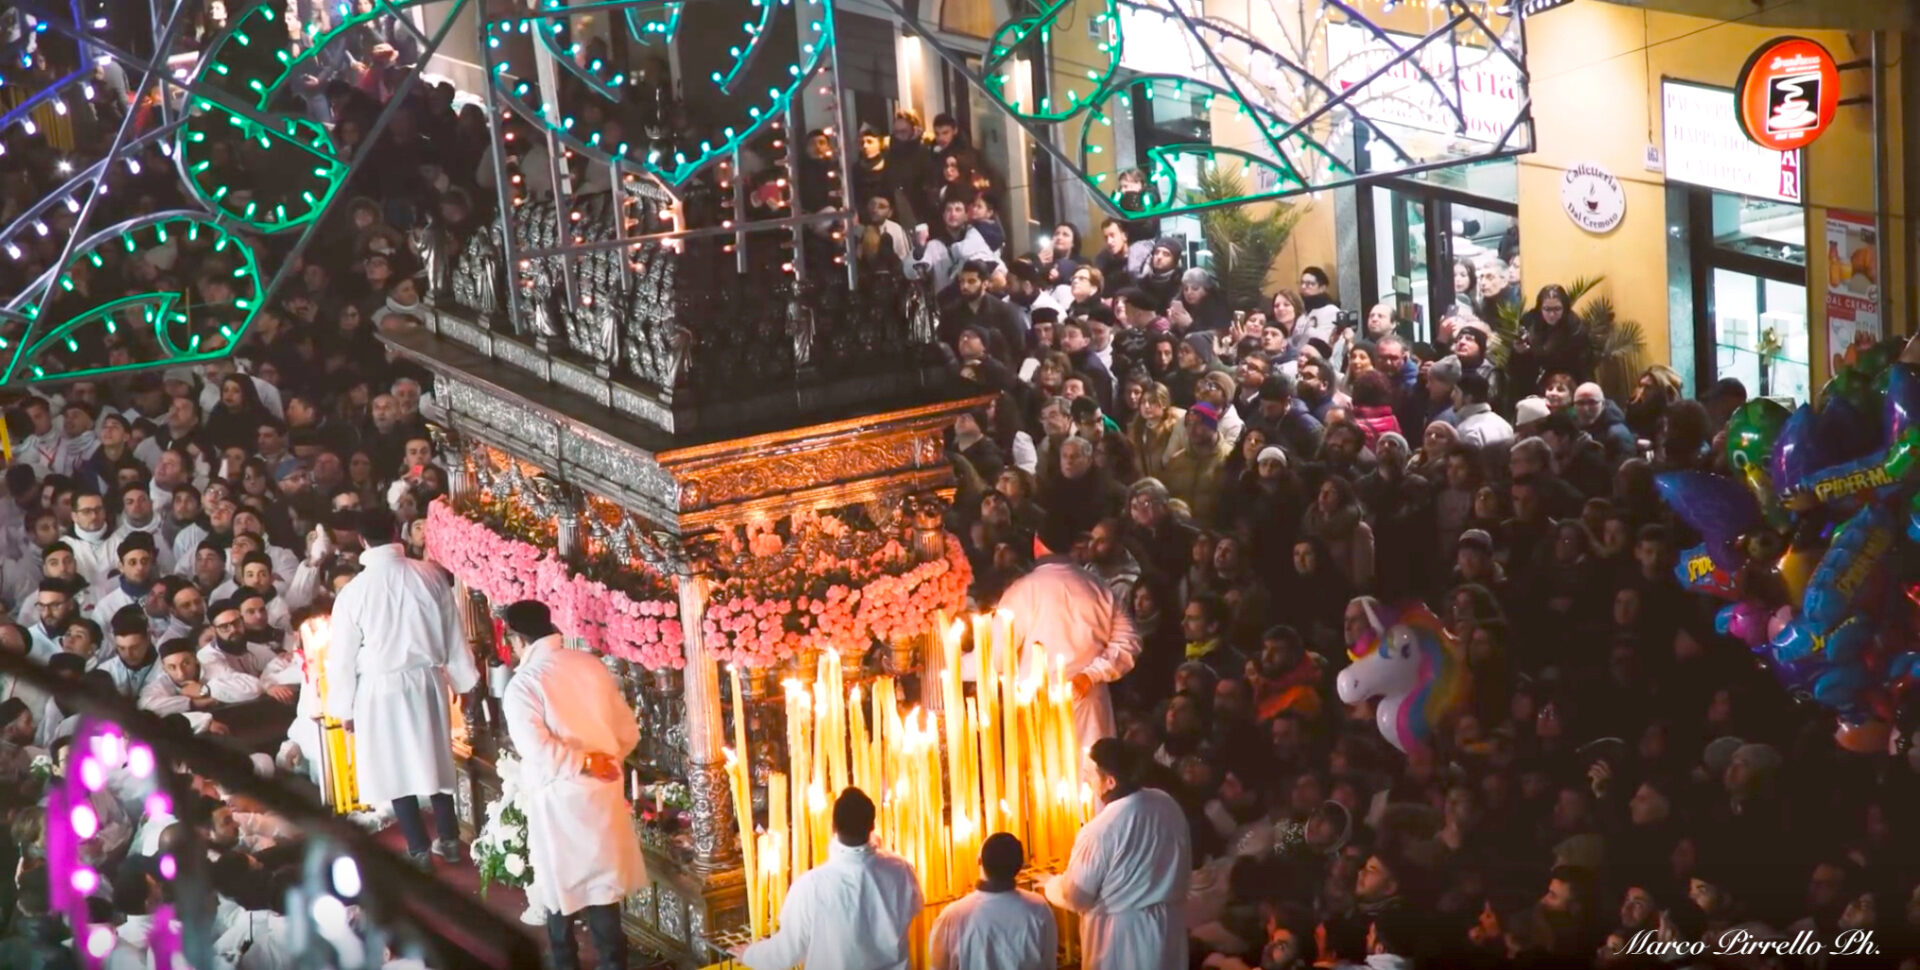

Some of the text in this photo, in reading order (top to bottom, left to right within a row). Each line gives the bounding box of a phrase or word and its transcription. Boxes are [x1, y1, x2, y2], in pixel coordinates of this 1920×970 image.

[1567, 202, 1618, 229] Dal Cremoso
[1814, 465, 1895, 503] SPIDER-M
